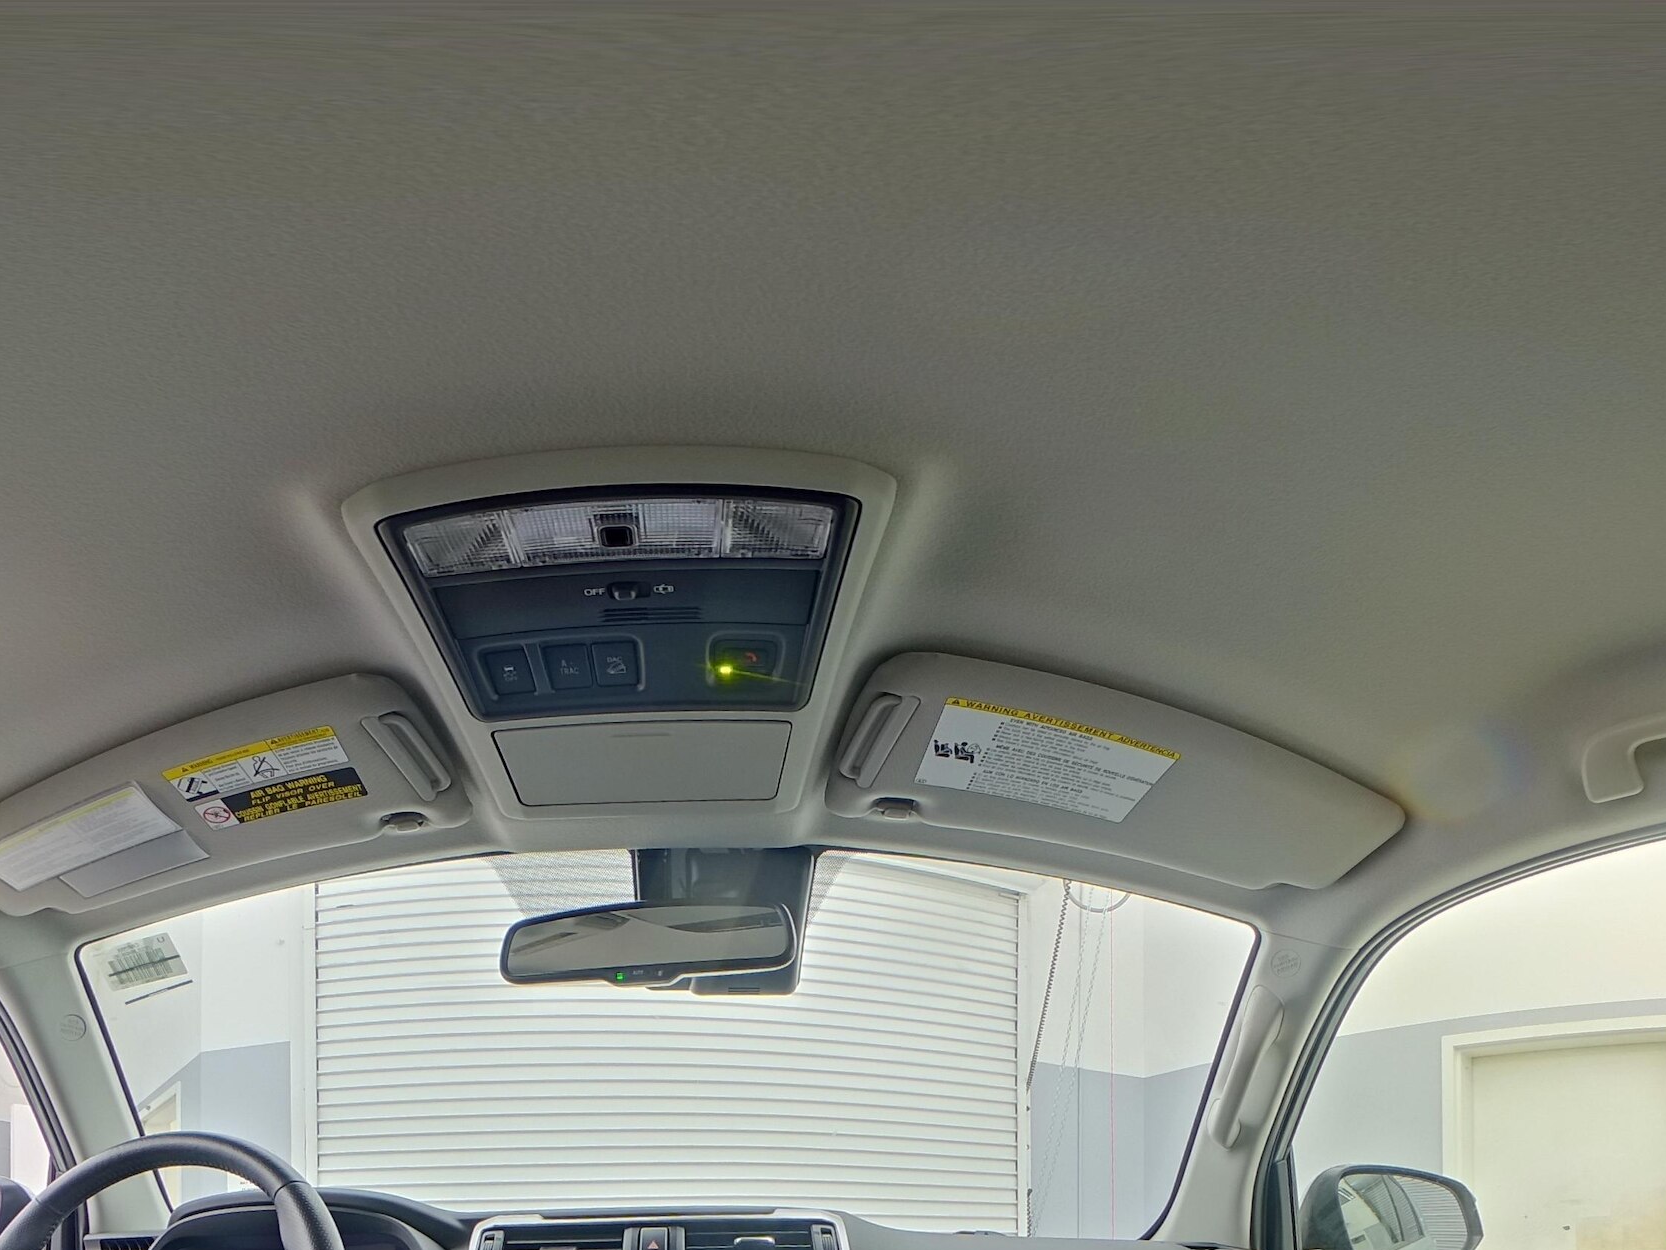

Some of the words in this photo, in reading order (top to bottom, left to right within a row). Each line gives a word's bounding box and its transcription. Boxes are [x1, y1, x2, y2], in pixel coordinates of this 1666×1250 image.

[584, 588, 605, 596] OFF
[966, 701, 1019, 716] WARNING
[1024, 711, 1116, 740] AVERTISSEMENT
[1118, 736, 1176, 758] ADVERTENCIA
[250, 789, 265, 799] AIR
[265, 784, 285, 795] BAG
[285, 774, 328, 790] WARNING
[252, 796, 271, 805] FLIP
[276, 788, 304, 799] VISOR
[308, 781, 335, 792] OVER
[307, 783, 363, 801] AVERTISSEMENT
